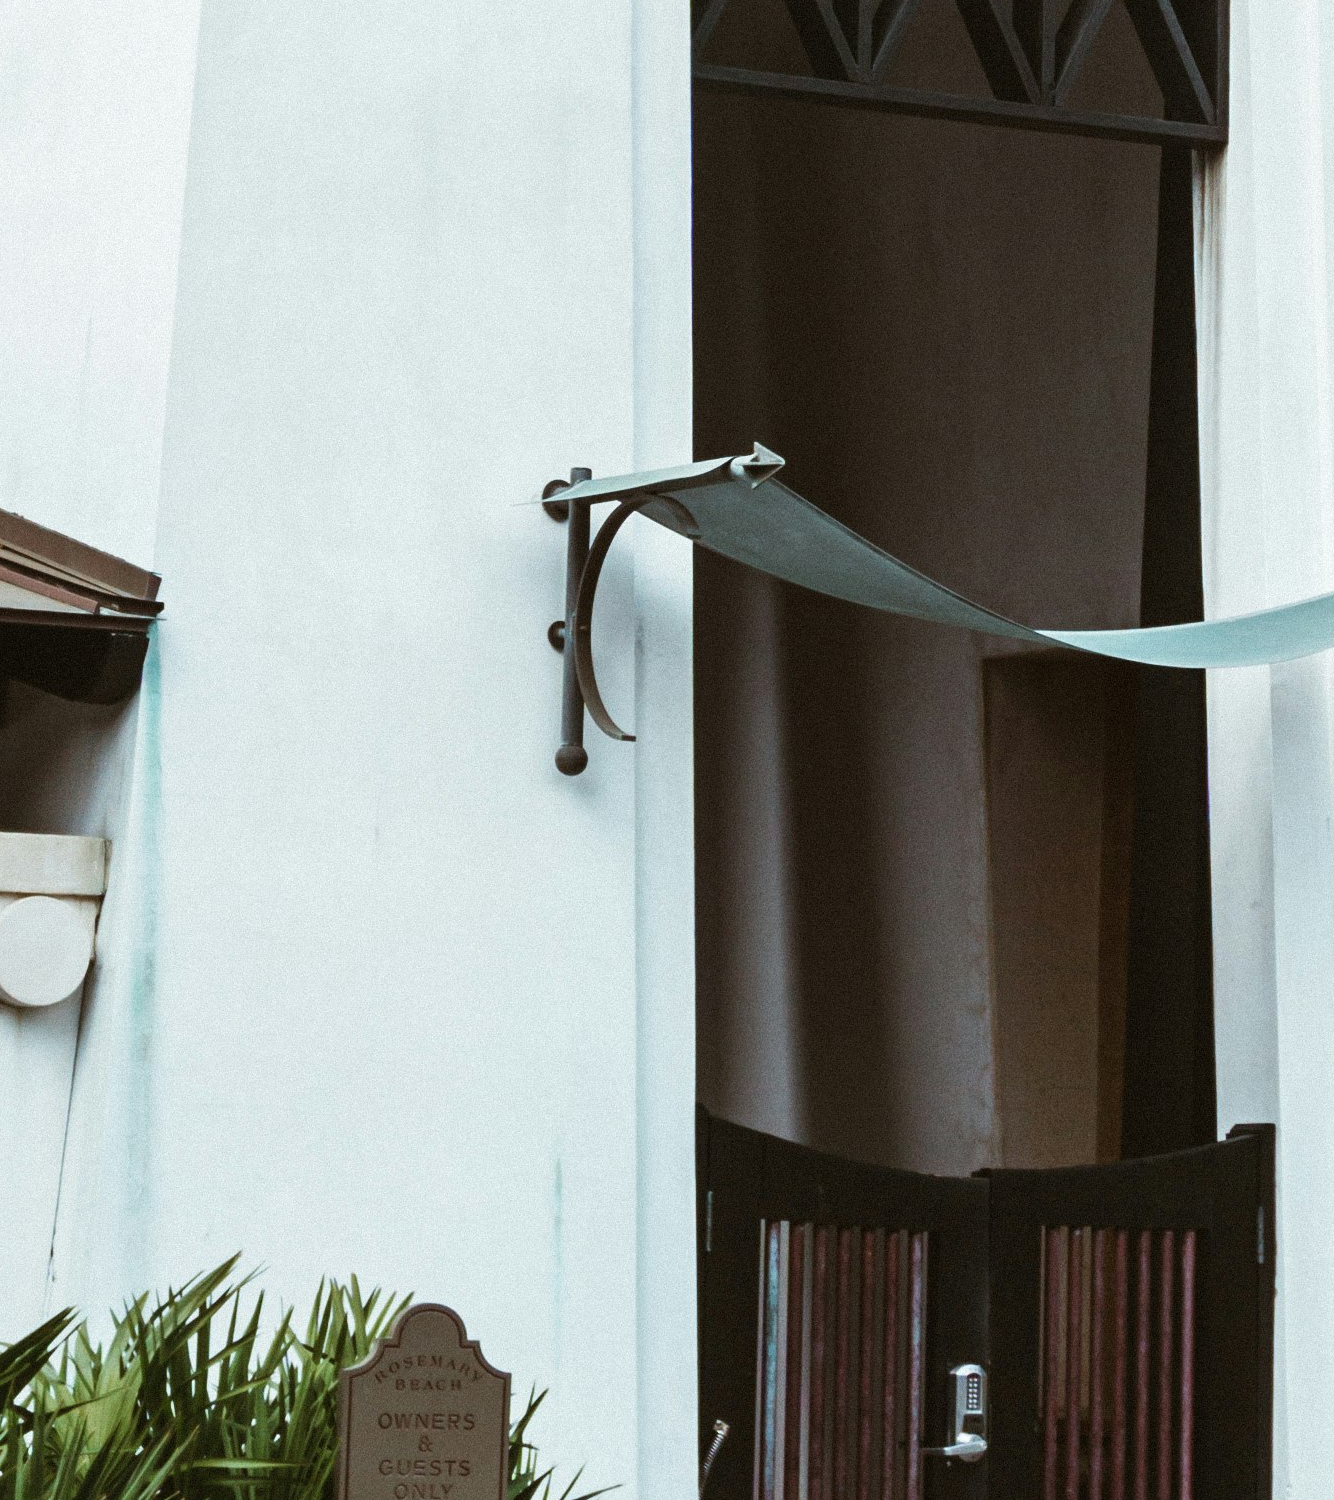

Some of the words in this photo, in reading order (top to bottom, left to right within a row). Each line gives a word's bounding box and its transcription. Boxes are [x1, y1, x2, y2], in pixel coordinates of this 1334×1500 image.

[375, 1355, 482, 1383] ROSEMARY
[395, 1379, 461, 1391] BEACH
[378, 1413, 475, 1431] OWNERS
[418, 1436, 433, 1452] &
[378, 1459, 471, 1477] GUESTS
[394, 1483, 453, 1500] ONLY
